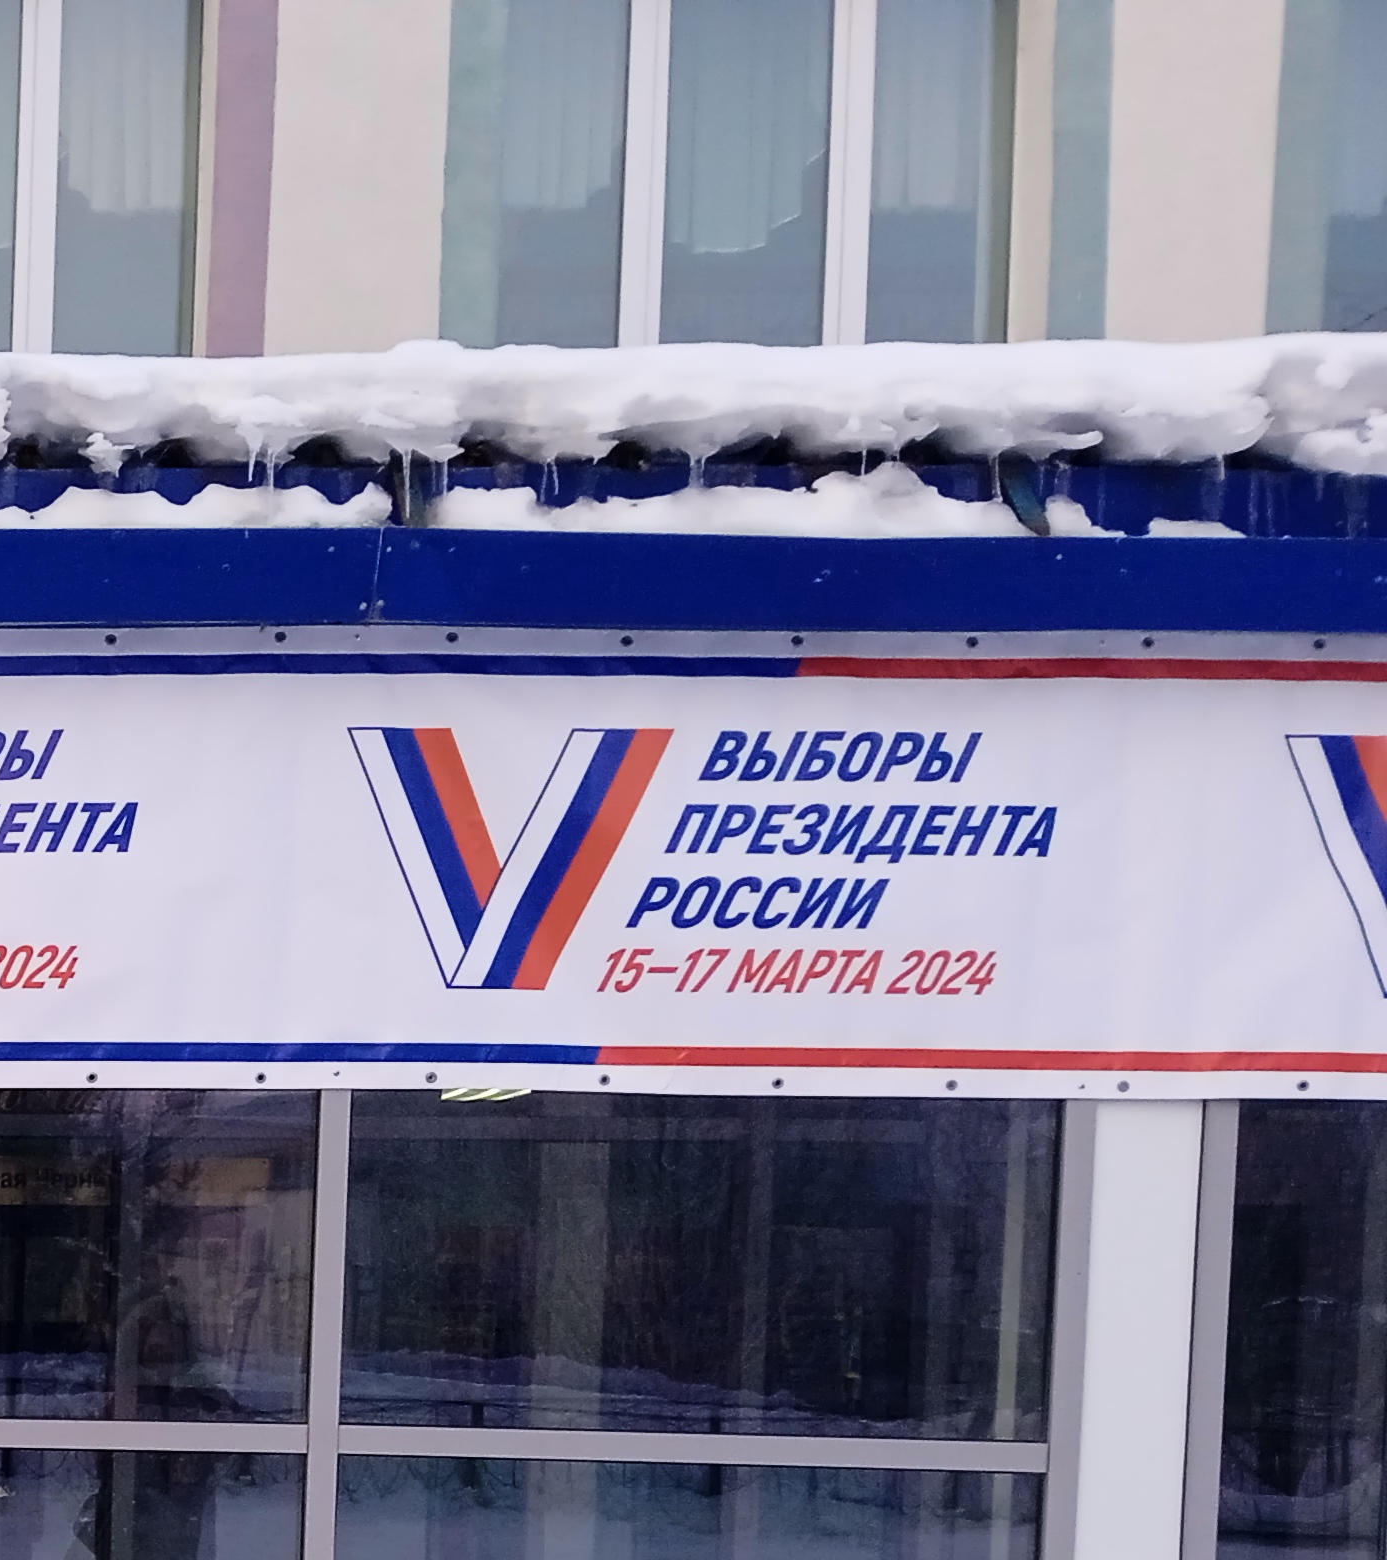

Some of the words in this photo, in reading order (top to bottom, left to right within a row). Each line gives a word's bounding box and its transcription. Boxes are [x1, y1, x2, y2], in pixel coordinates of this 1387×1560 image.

[699, 731, 983, 783] ВЫБОРЫ
[665, 804, 1057, 864] ПРЕЗИДЕНТА
[625, 876, 890, 929] РОССИИ
[726, 949, 884, 994] МАРТА
[884, 950, 997, 995] 2024
